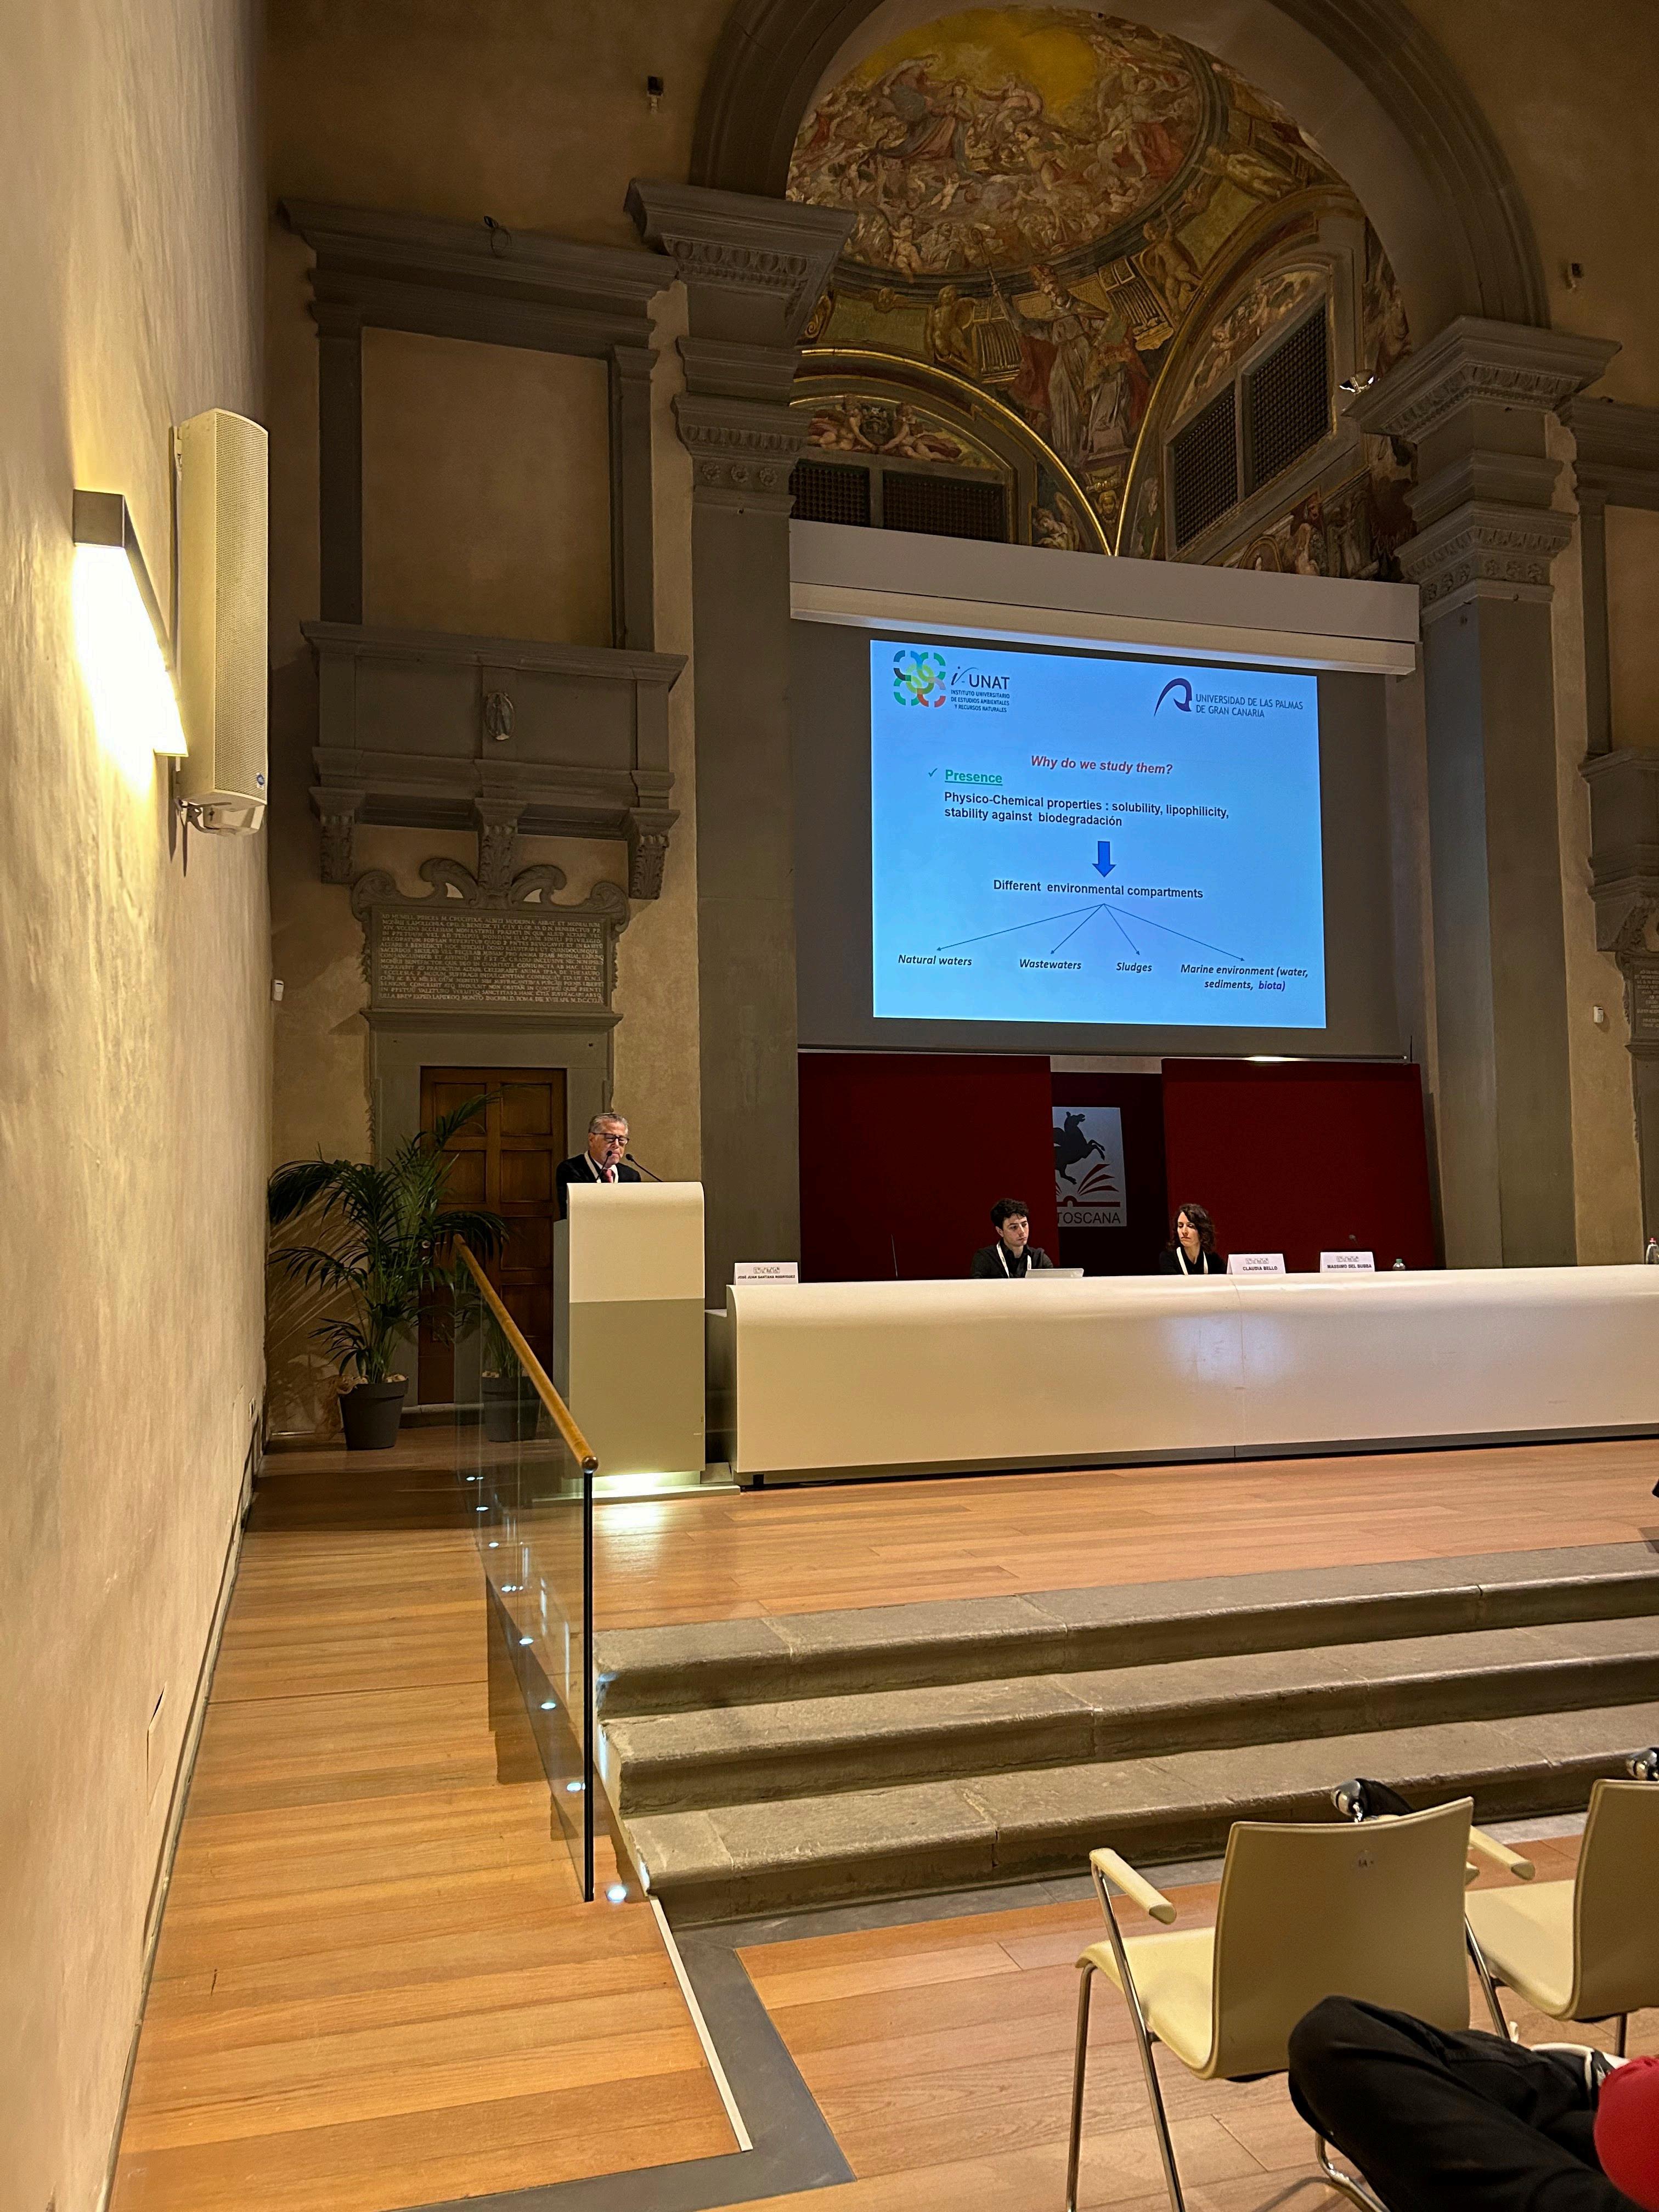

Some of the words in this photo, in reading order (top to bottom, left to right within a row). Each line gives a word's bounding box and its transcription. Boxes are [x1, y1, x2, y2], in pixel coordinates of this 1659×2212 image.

[1196, 694, 1245, 705] UNIVERSIDAD
[1248, 698, 1257, 706] DE
[1260, 699, 1273, 708] LAS
[1276, 700, 1303, 710] PALMAS
[1196, 705, 1205, 713] DE
[1209, 706, 1229, 714] GRAN
[1232, 707, 1265, 718] CANARIA
[1031, 755, 1058, 770] Why
[1061, 758, 1076, 769] do
[1080, 760, 1096, 770] we
[1099, 760, 1133, 774] study
[1136, 762, 1173, 774] them?
[945, 769, 1003, 785] Presence
[944, 792, 1043, 808] Physico-Chemical
[1047, 799, 1102, 811] properties
[1112, 802, 1163, 815] solubility,
[1166, 804, 1229, 819] lipophilicity,
[945, 807, 989, 821] stability
[992, 810, 1032, 822] against
[1039, 812, 1122, 826] biodegradación
[994, 880, 1041, 891] Different
[1047, 883, 1124, 895] environmental
[1127, 887, 1203, 899] compartments
[898, 955, 936, 964] Natural
[939, 957, 972, 966] waters
[1019, 959, 1082, 969] Wastewaters
[1116, 962, 1152, 973] Sludges
[1181, 964, 1214, 974] Marine
[1216, 966, 1274, 976] environment
[1276, 966, 1308, 978] (water,
[1204, 980, 1254, 991] sediments,
[1259, 980, 1285, 991] biota)
